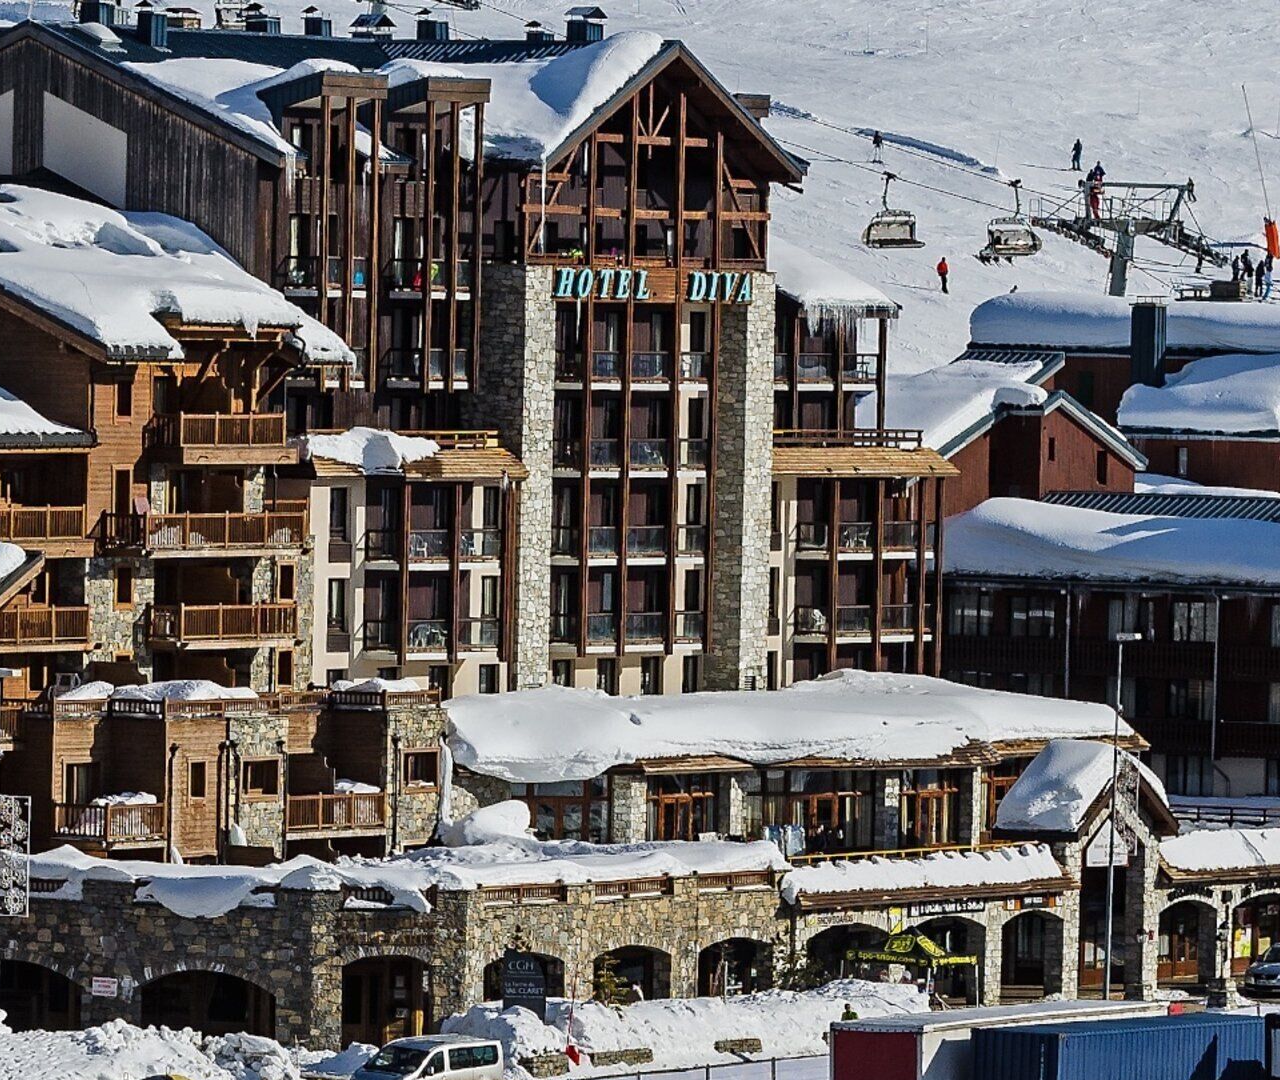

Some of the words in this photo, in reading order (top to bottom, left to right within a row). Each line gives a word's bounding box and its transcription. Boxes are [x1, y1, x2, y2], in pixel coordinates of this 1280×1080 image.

[554, 268, 651, 299] HOTEL
[687, 270, 753, 302] DIVA
[508, 959, 534, 971] CGH
